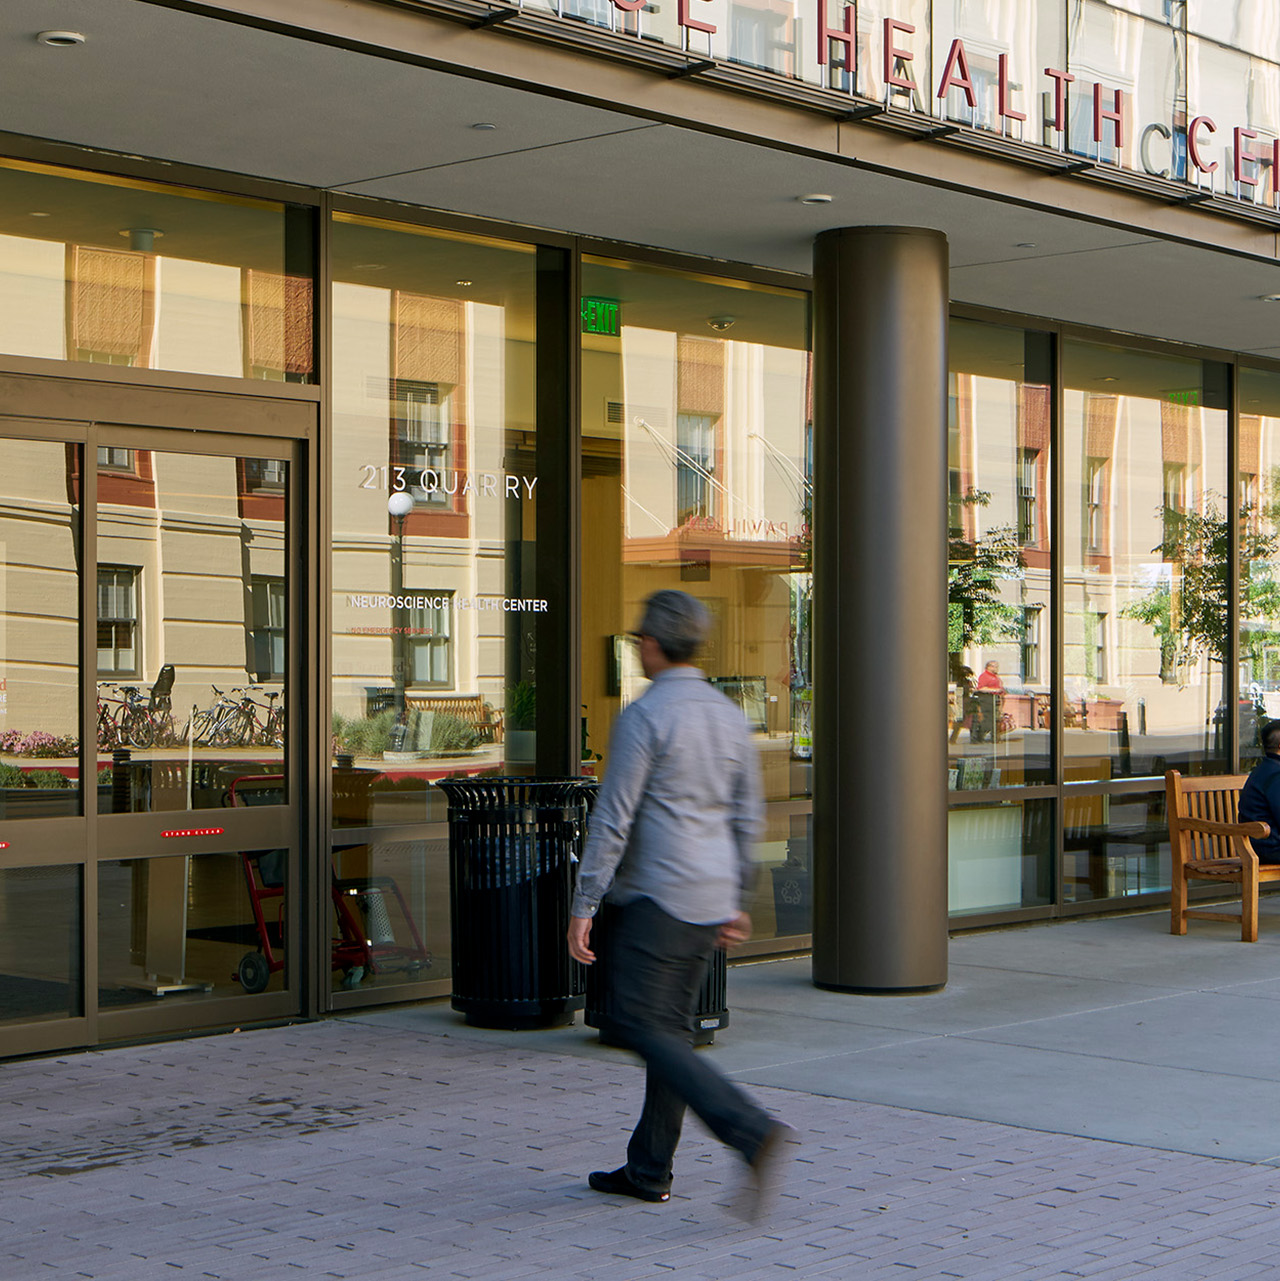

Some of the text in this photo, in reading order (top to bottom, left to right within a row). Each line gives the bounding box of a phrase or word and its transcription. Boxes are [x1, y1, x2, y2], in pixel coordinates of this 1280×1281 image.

[587, 300, 618, 334] EXIT
[363, 464, 538, 499] 213 QUARRY
[351, 595, 548, 612] NEUROSCIENCE HEALTH CENTER
